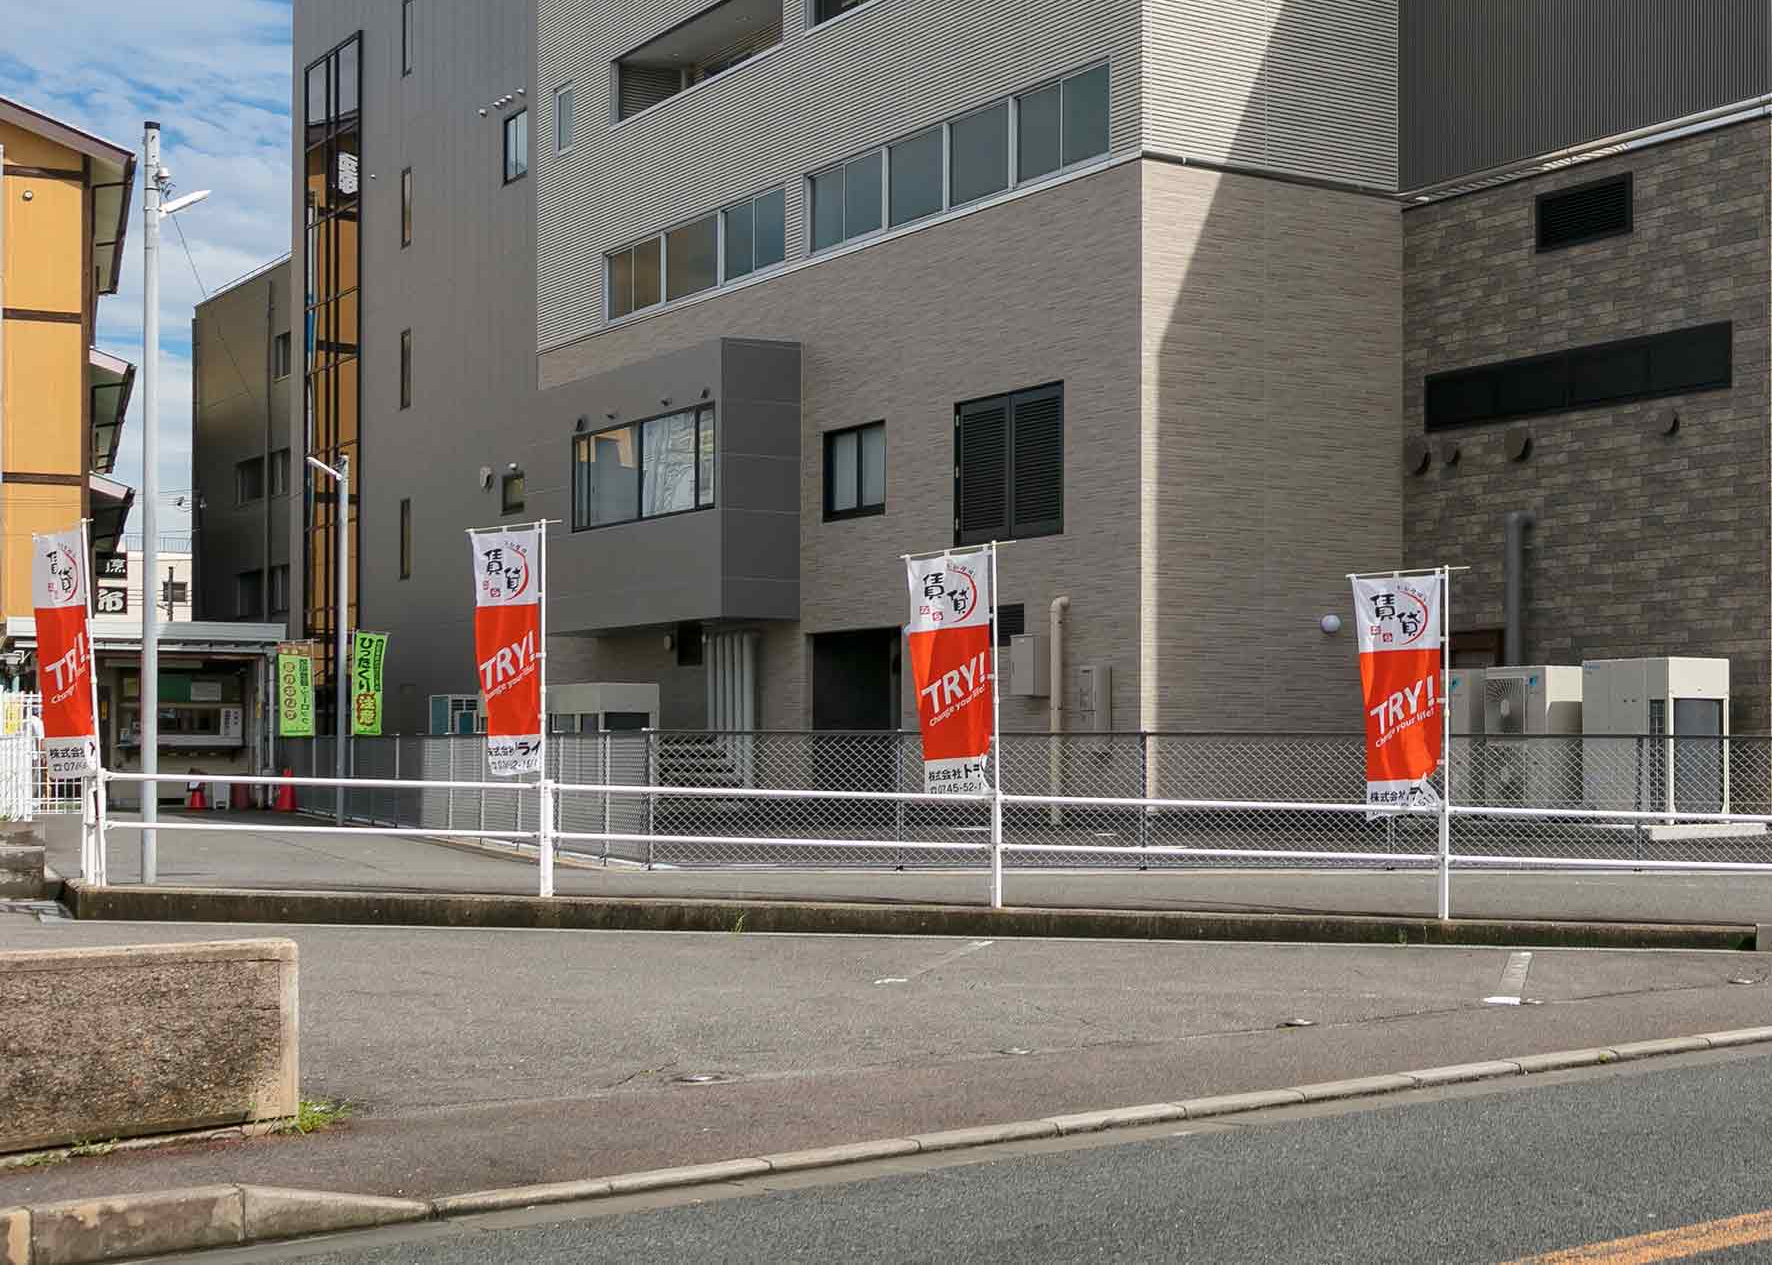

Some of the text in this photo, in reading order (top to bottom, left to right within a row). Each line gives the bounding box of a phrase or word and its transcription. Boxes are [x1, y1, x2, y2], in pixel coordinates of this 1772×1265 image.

[480, 631, 536, 691] TRY!
[921, 652, 985, 714] TRY!
[1370, 675, 1435, 735] TRY!
